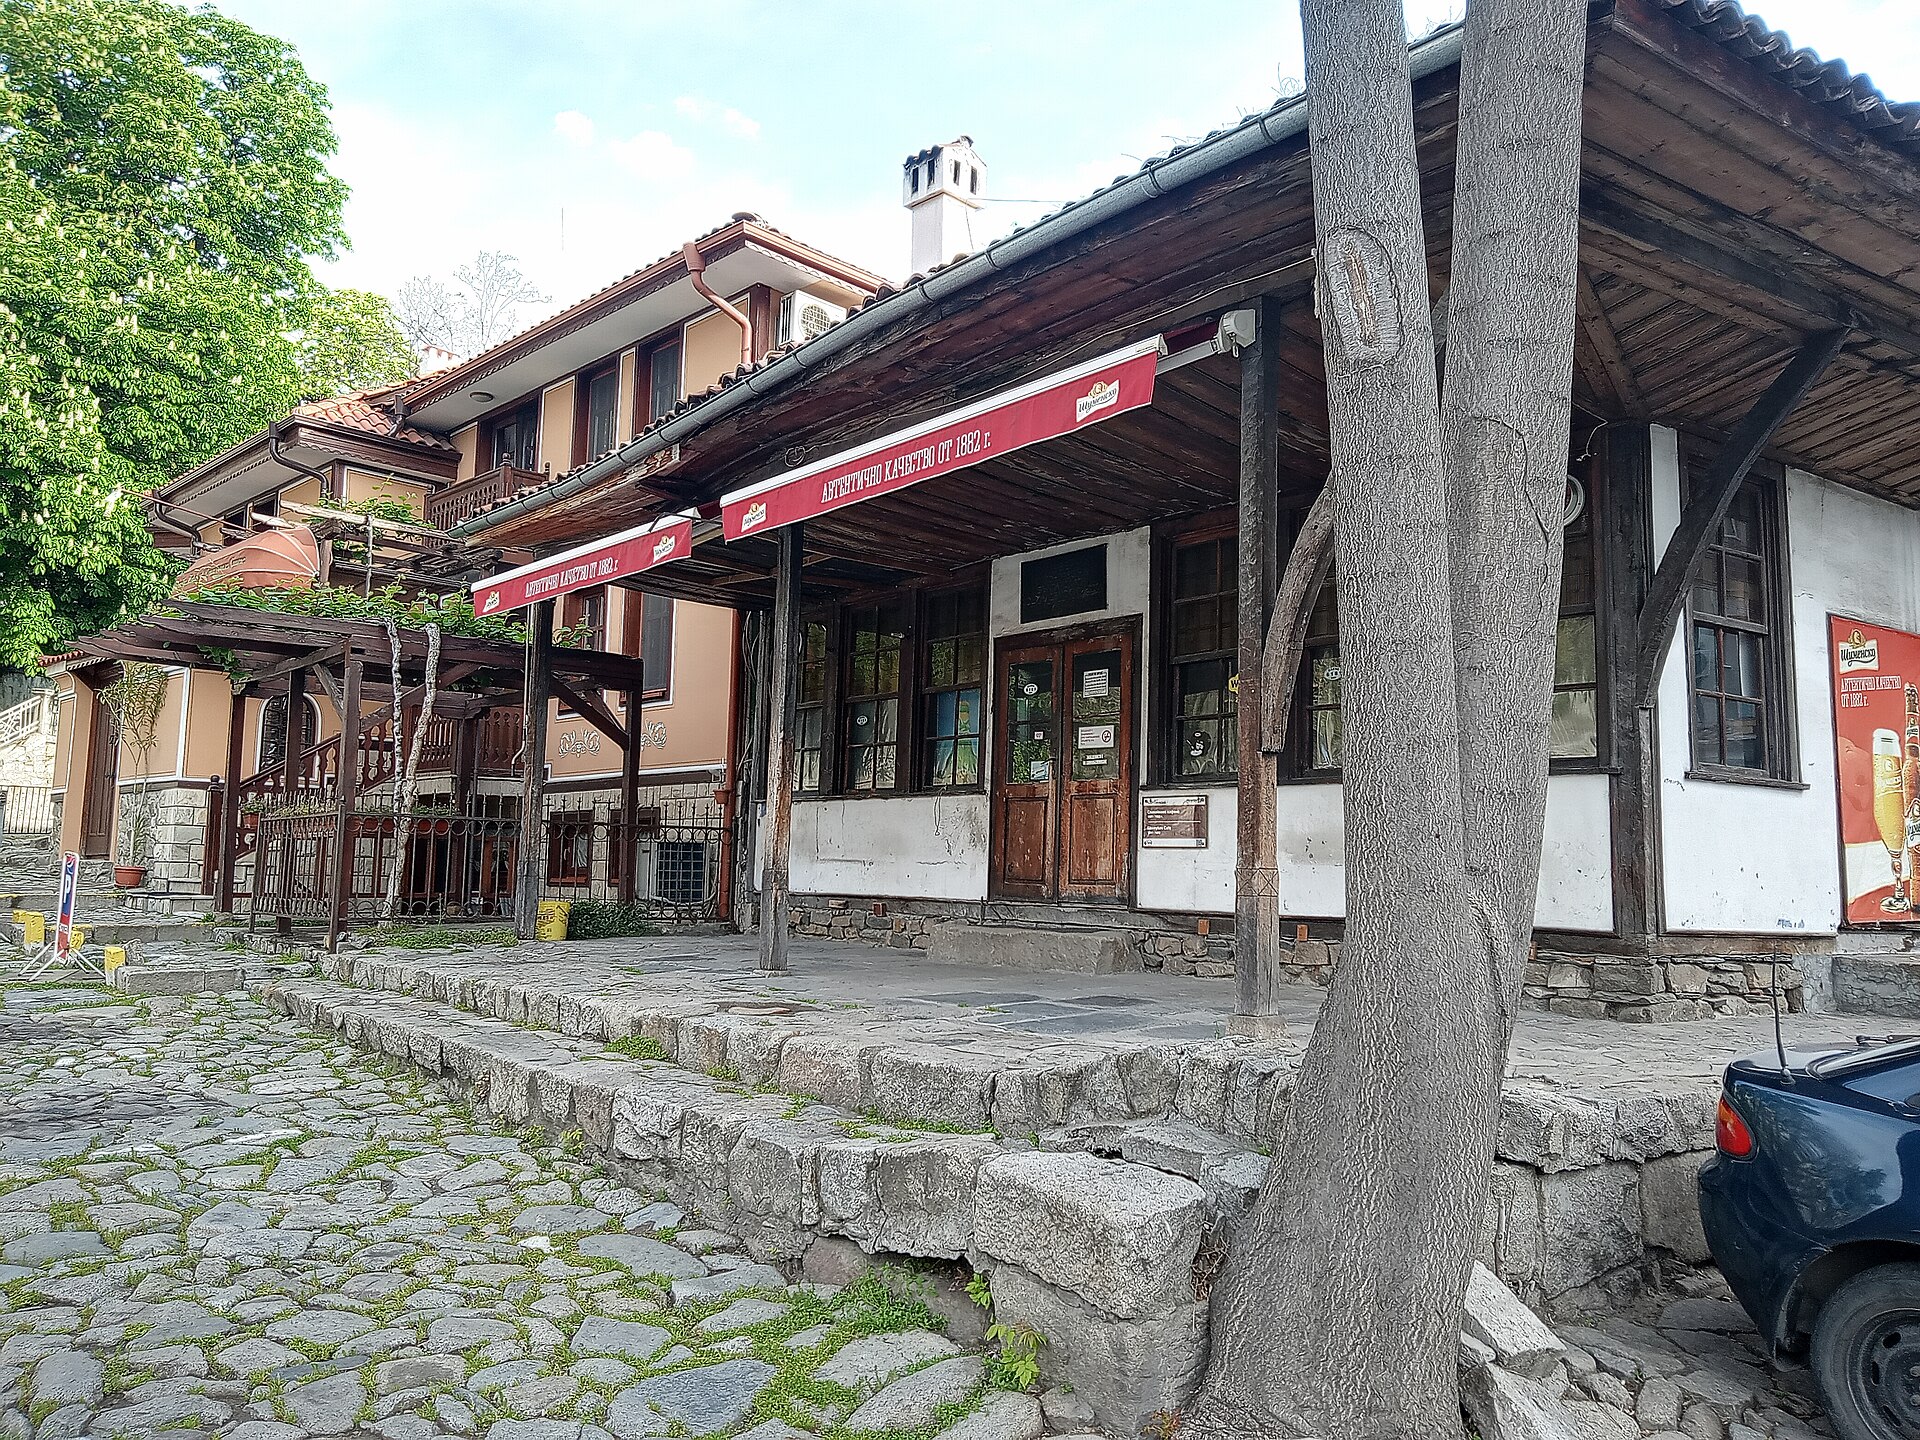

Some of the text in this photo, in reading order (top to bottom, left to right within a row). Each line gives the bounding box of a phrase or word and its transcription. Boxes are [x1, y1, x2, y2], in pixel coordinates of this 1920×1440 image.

[821, 464, 882, 503] АВТЕНТИЧНО
[884, 445, 935, 482] КАЧЕСТВО
[938, 439, 953, 465] ОТ
[955, 430, 981, 458] 1882
